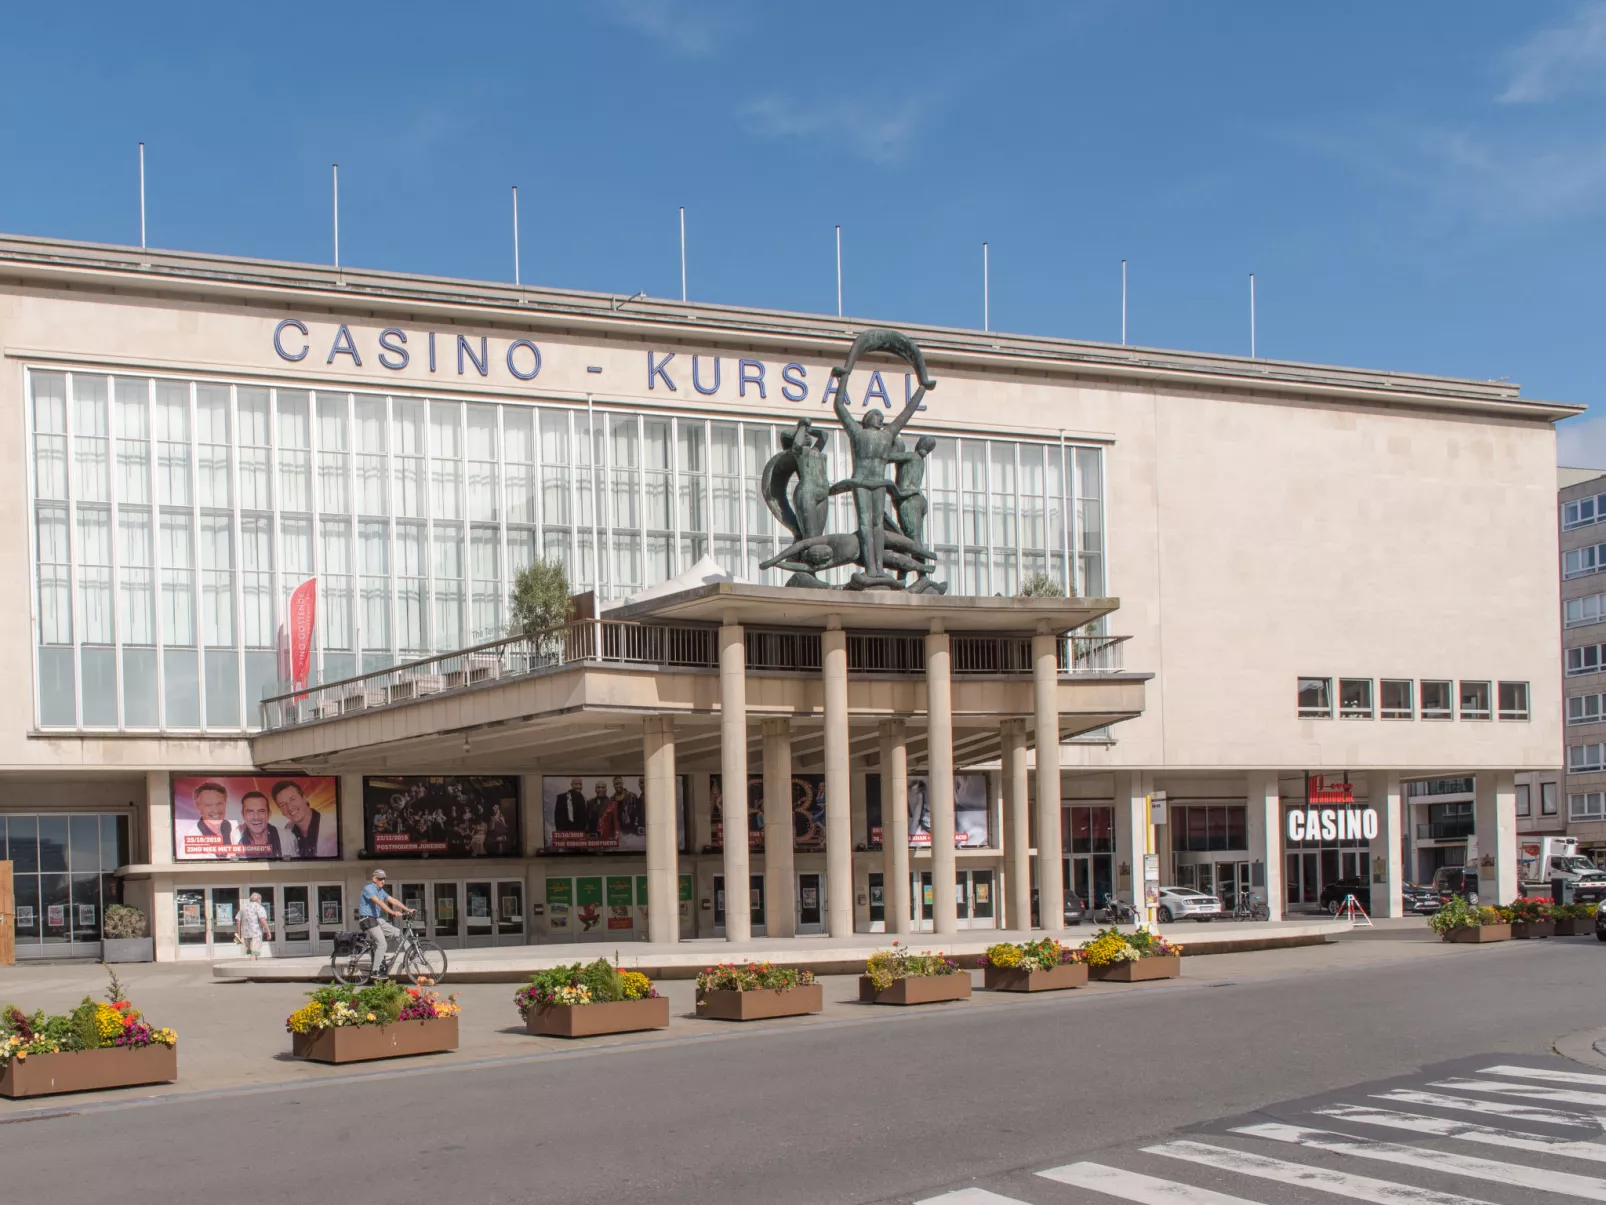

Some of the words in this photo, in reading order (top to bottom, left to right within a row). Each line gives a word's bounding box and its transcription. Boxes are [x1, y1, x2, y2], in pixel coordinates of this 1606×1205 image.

[273, 318, 543, 381] CASINO
[647, 350, 928, 412] KURSAAL
[1287, 808, 1378, 841] CASINO
[218, 845, 232, 853] MET
